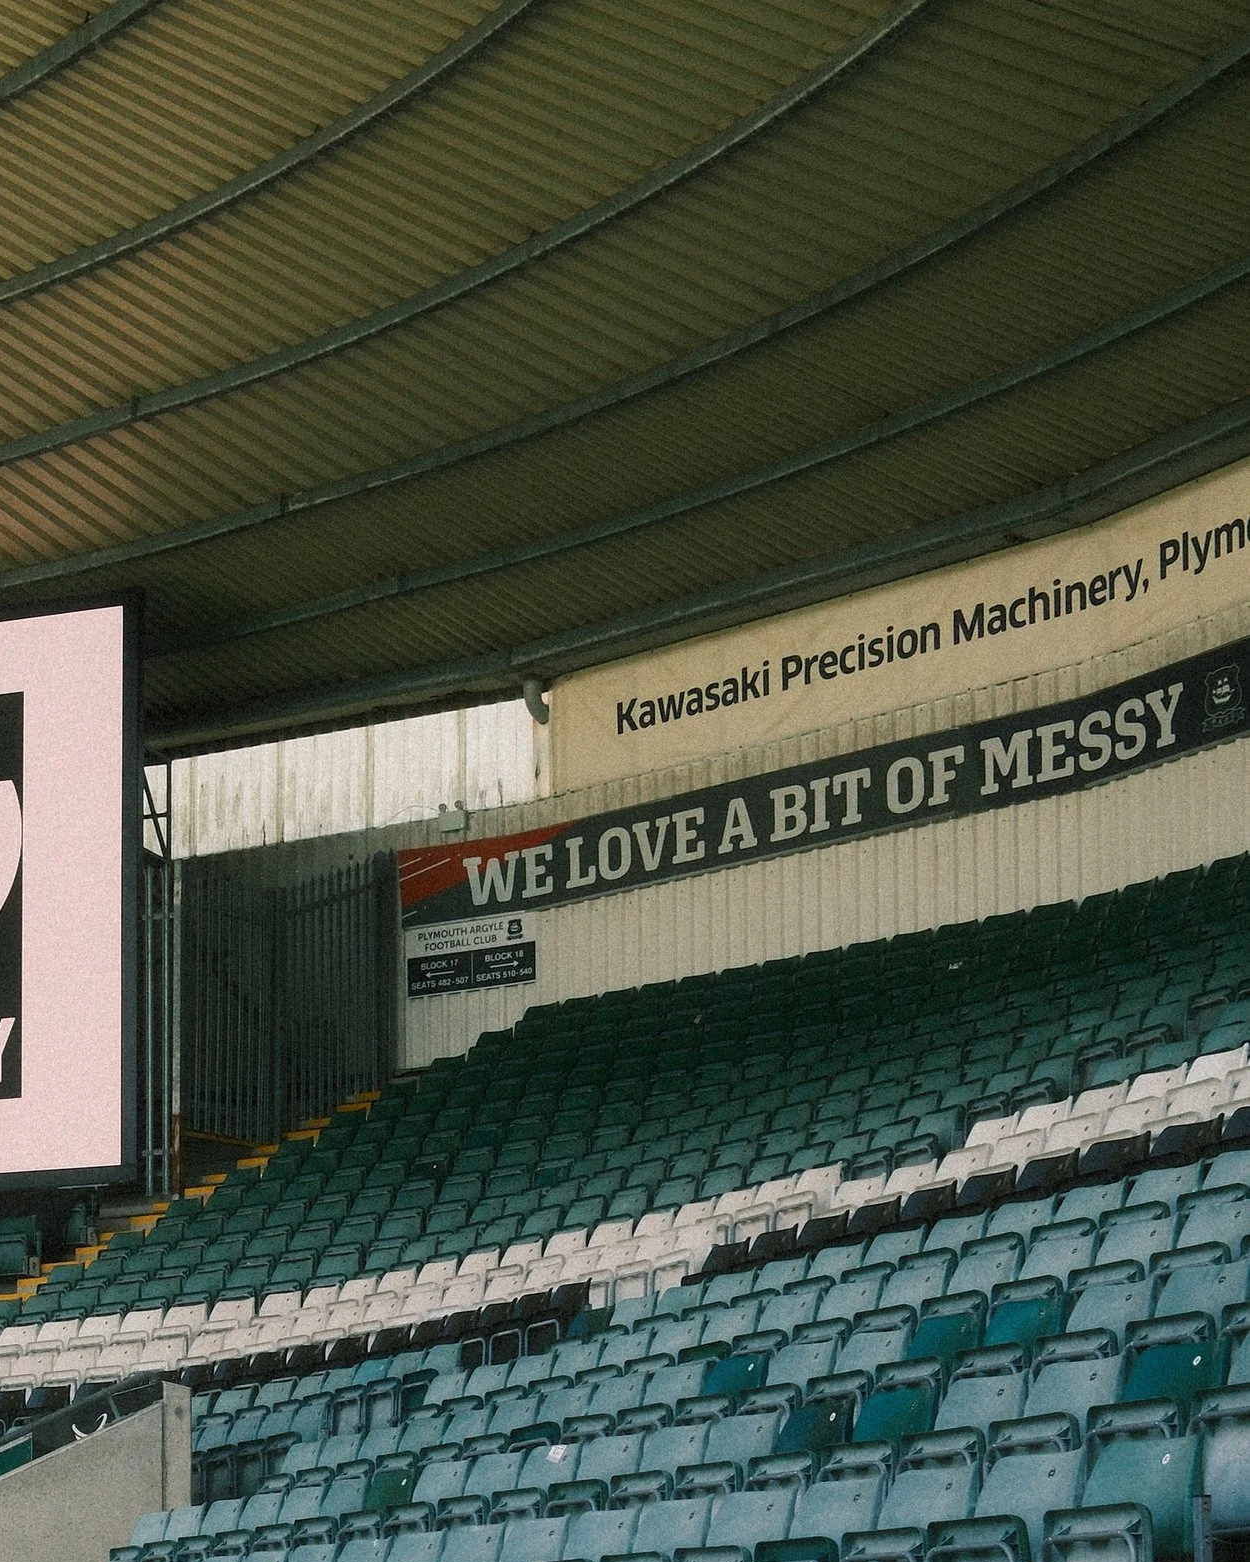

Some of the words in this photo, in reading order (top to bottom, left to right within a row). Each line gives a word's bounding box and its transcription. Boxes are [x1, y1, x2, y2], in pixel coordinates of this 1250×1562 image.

[616, 659, 771, 735] Kawasaki
[781, 617, 941, 692] Precision
[953, 557, 1150, 646] Machinery,
[1159, 516, 1250, 581] Plym
[462, 845, 554, 907] WE
[566, 806, 706, 890] LOVE
[718, 798, 762, 855] A
[770, 766, 871, 844] BIT
[886, 745, 968, 814] OF
[980, 682, 1185, 797] MESSY
[417, 928, 467, 941] PLYMOUTH
[470, 921, 504, 934] ARGYLE
[424, 939, 470, 952] FOOTBALL
[473, 934, 497, 945] CLUB
[485, 951, 512, 962] BLOCK
[515, 949, 524, 957] 18
[421, 961, 448, 971] BLOCK
[450, 959, 458, 967] 17
[476, 971, 501, 981] SEATS
[411, 981, 436, 990] SEATS
